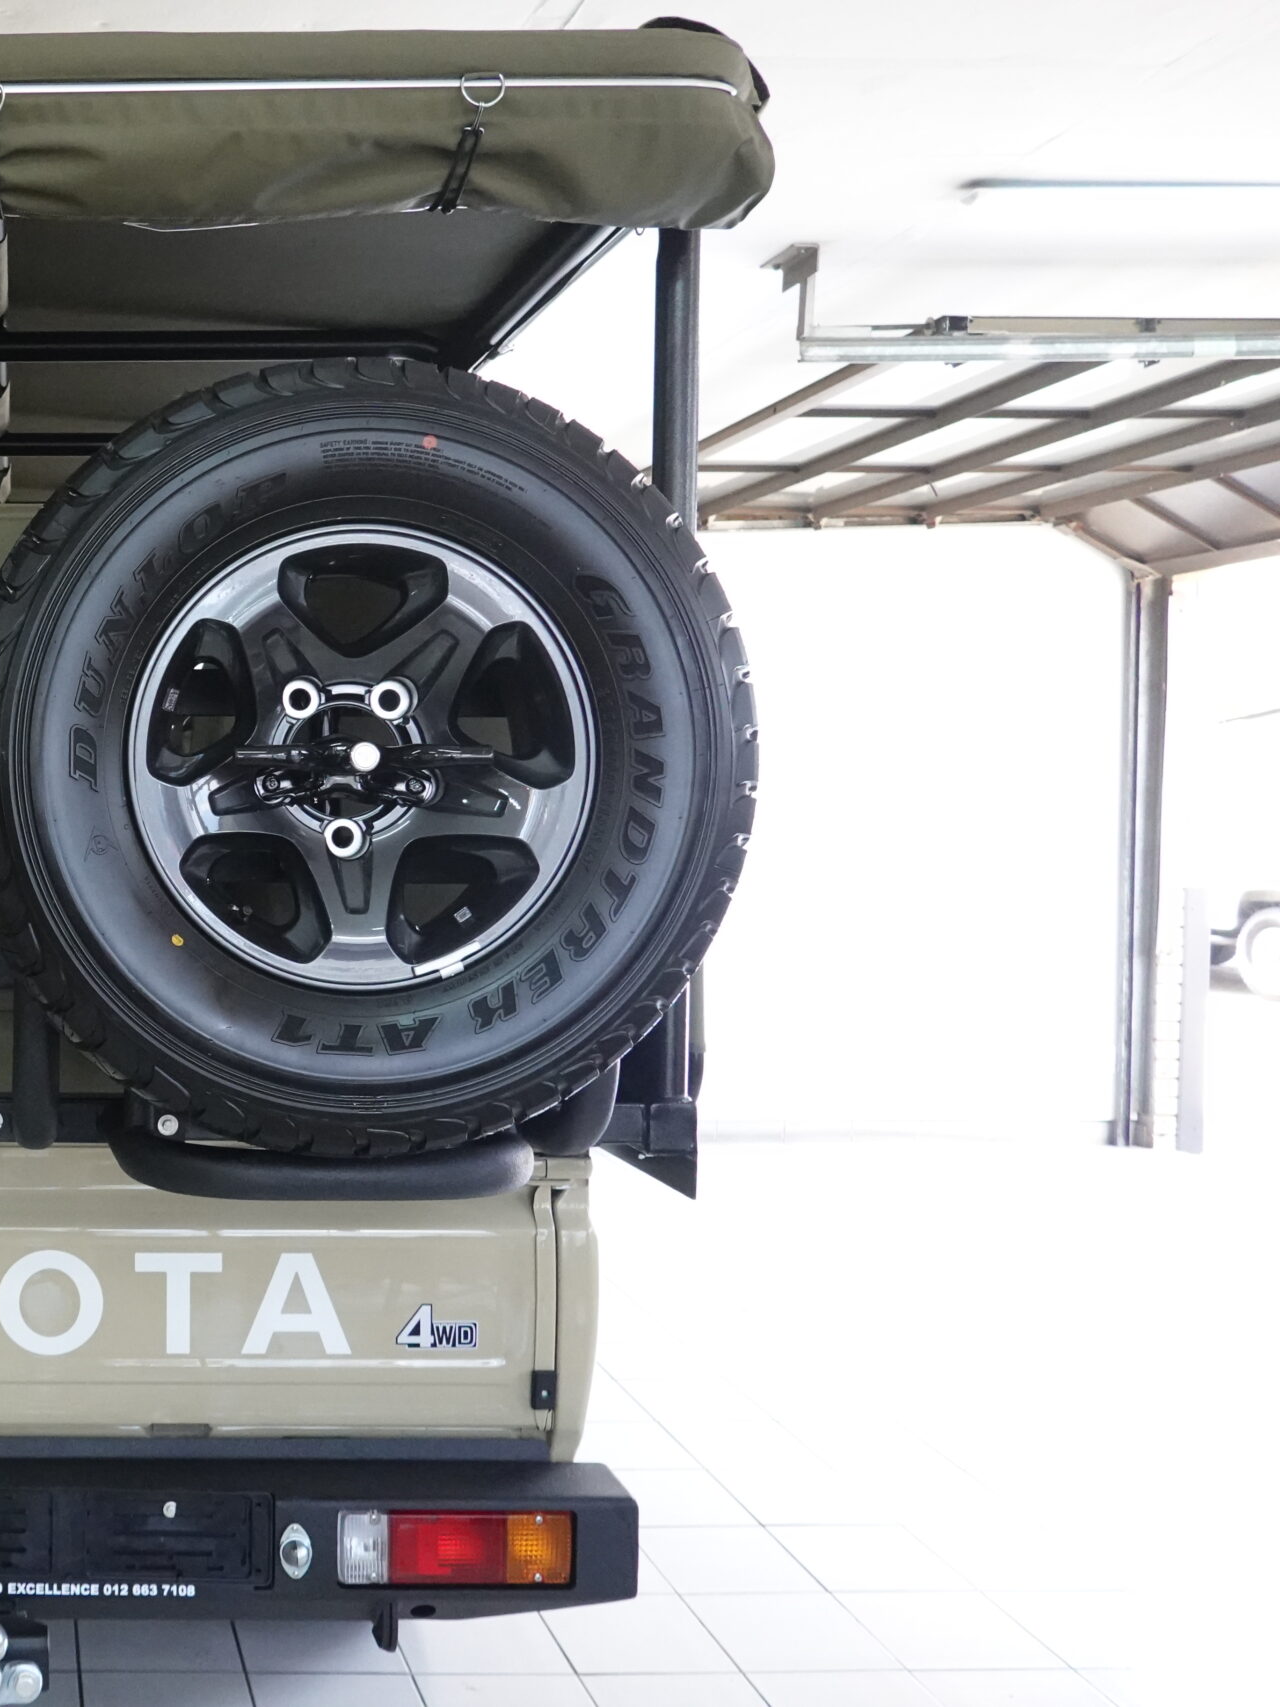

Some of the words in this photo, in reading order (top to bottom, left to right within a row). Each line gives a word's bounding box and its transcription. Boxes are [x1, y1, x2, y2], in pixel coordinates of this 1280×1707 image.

[70, 473, 287, 788] DUNLOP
[474, 573, 667, 1032] GRANDTREK
[396, 1303, 478, 1348] 4WD
[8, 1582, 99, 1596] EXCELLENCE
[103, 1583, 128, 1596] 012
